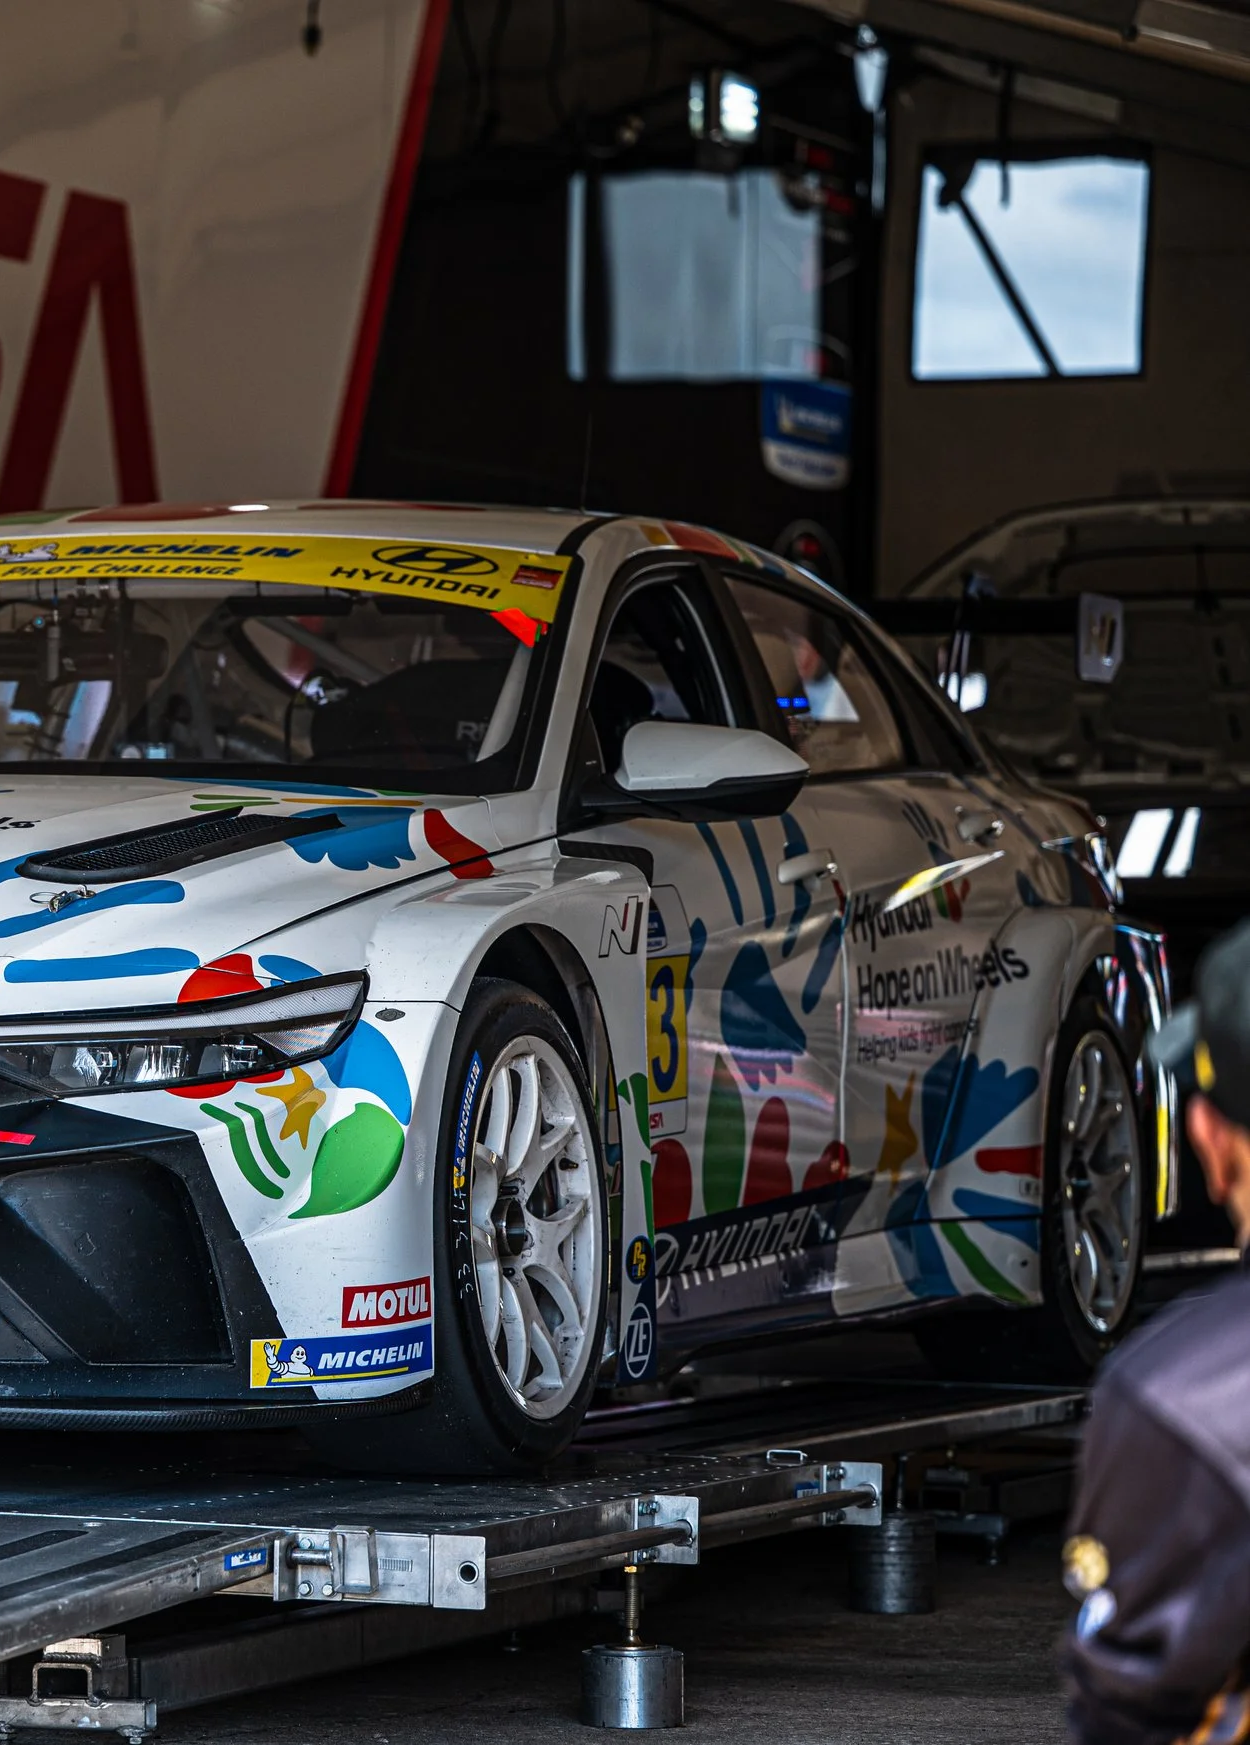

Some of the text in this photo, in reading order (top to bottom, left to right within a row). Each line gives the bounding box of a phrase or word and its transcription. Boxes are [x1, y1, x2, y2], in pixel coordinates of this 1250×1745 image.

[1, 563, 244, 577] PILOT CHALLENGE
[65, 543, 305, 559] MICHELIN
[330, 566, 501, 600] HYUNDAI
[850, 893, 934, 951] Hyundai
[857, 939, 1030, 1020] Hope on Wheels
[457, 1059, 481, 1153] MICHELIN
[678, 1204, 817, 1290] HYUNDAI
[348, 1283, 429, 1321] MOTUL
[318, 1341, 424, 1370] MICHELIN
[627, 1318, 650, 1363] ZF
